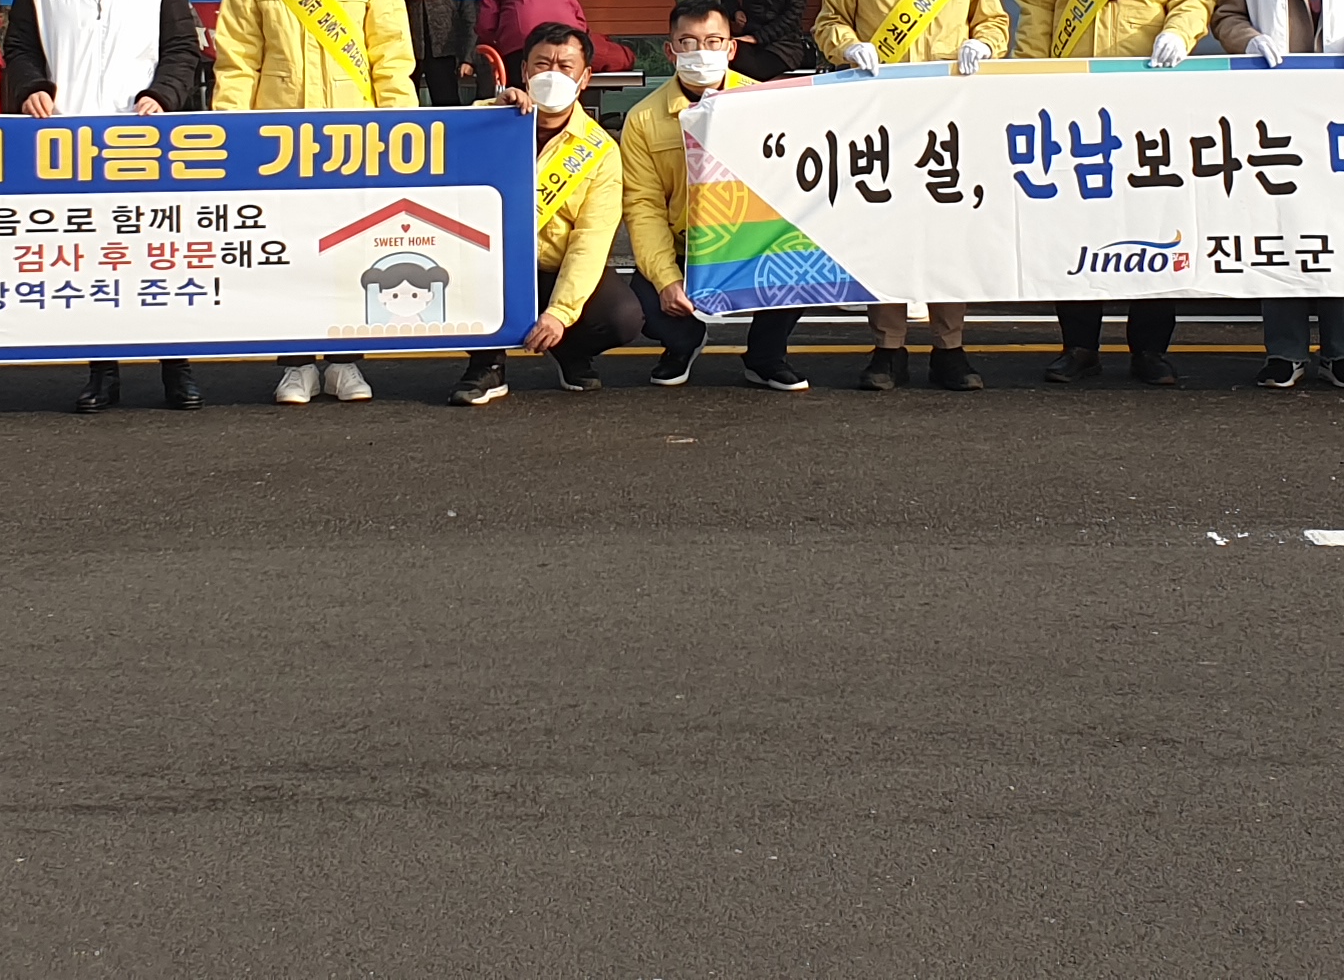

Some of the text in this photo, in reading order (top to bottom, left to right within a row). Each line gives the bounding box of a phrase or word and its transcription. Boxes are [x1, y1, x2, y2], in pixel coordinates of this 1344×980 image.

[878, 13, 918, 58] 이제는
[37, 125, 227, 180] 마음은
[259, 121, 445, 177] 가까이
[915, 122, 983, 209] 설,
[1006, 108, 1303, 199] 만남보다는
[112, 205, 180, 234] 함께
[197, 204, 266, 232] 해요
[14, 244, 84, 272] 검사
[99, 242, 131, 271] 후
[148, 240, 290, 270] 방문해요
[373, 236, 437, 249] SWEET HOME
[1067, 242, 1172, 276] Jindo
[1207, 235, 1334, 273] 진도군
[138, 277, 220, 306] 준수!
